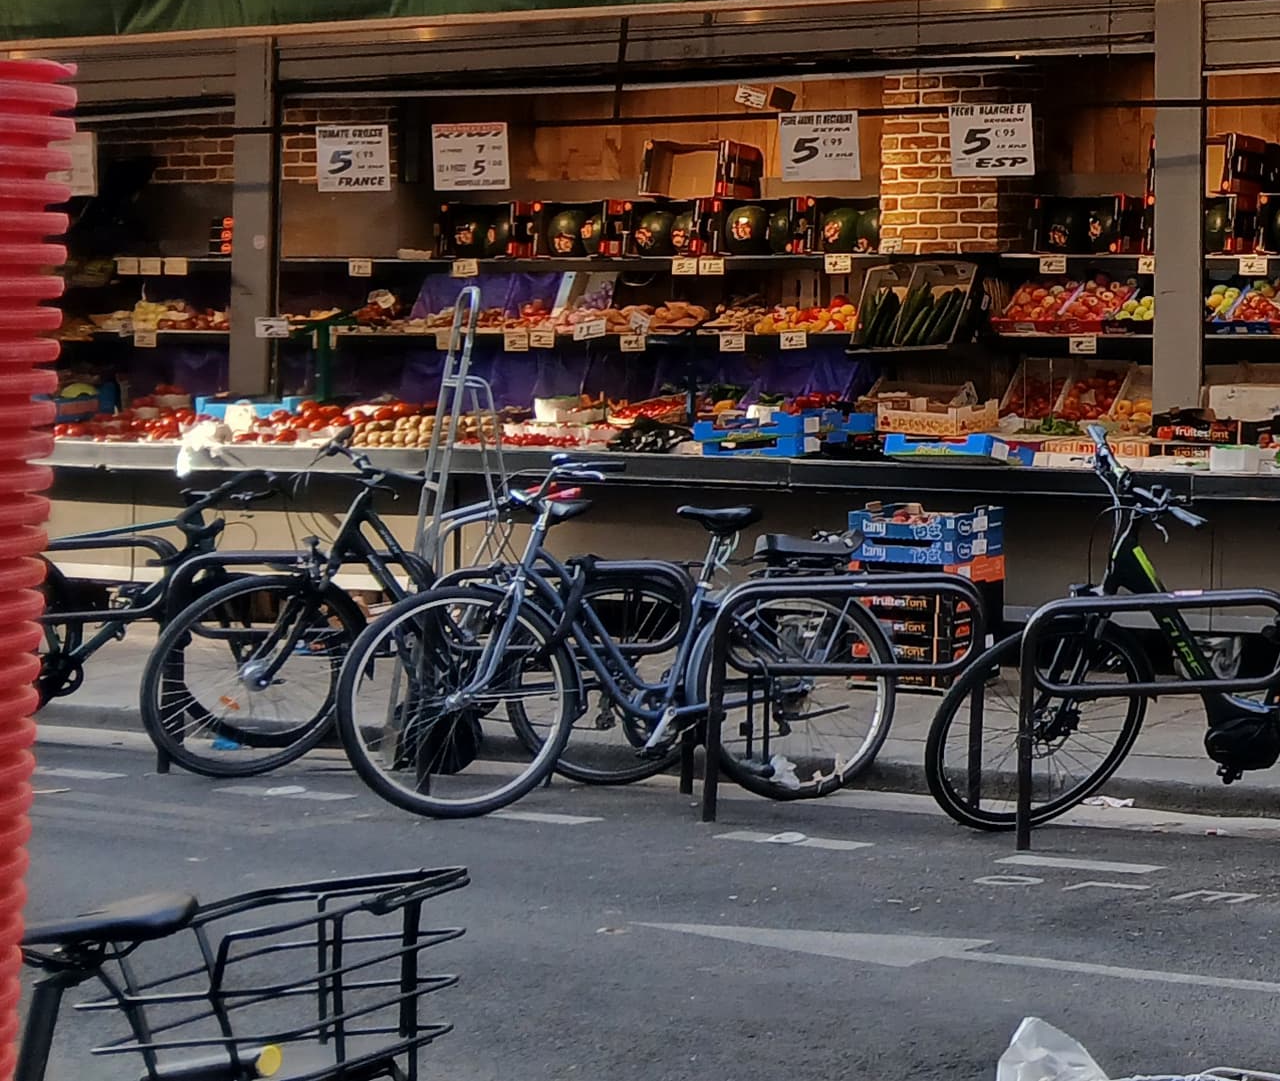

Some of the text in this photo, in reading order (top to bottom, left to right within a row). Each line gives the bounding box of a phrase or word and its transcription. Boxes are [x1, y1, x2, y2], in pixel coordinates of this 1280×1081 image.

[1003, 128, 1016, 137] 95
[962, 127, 991, 155] 5
[792, 137, 820, 164] 5
[328, 150, 352, 174] 5
[472, 160, 486, 176] 5
[975, 157, 1028, 168] ESP
[338, 176, 384, 187] FRANCE
